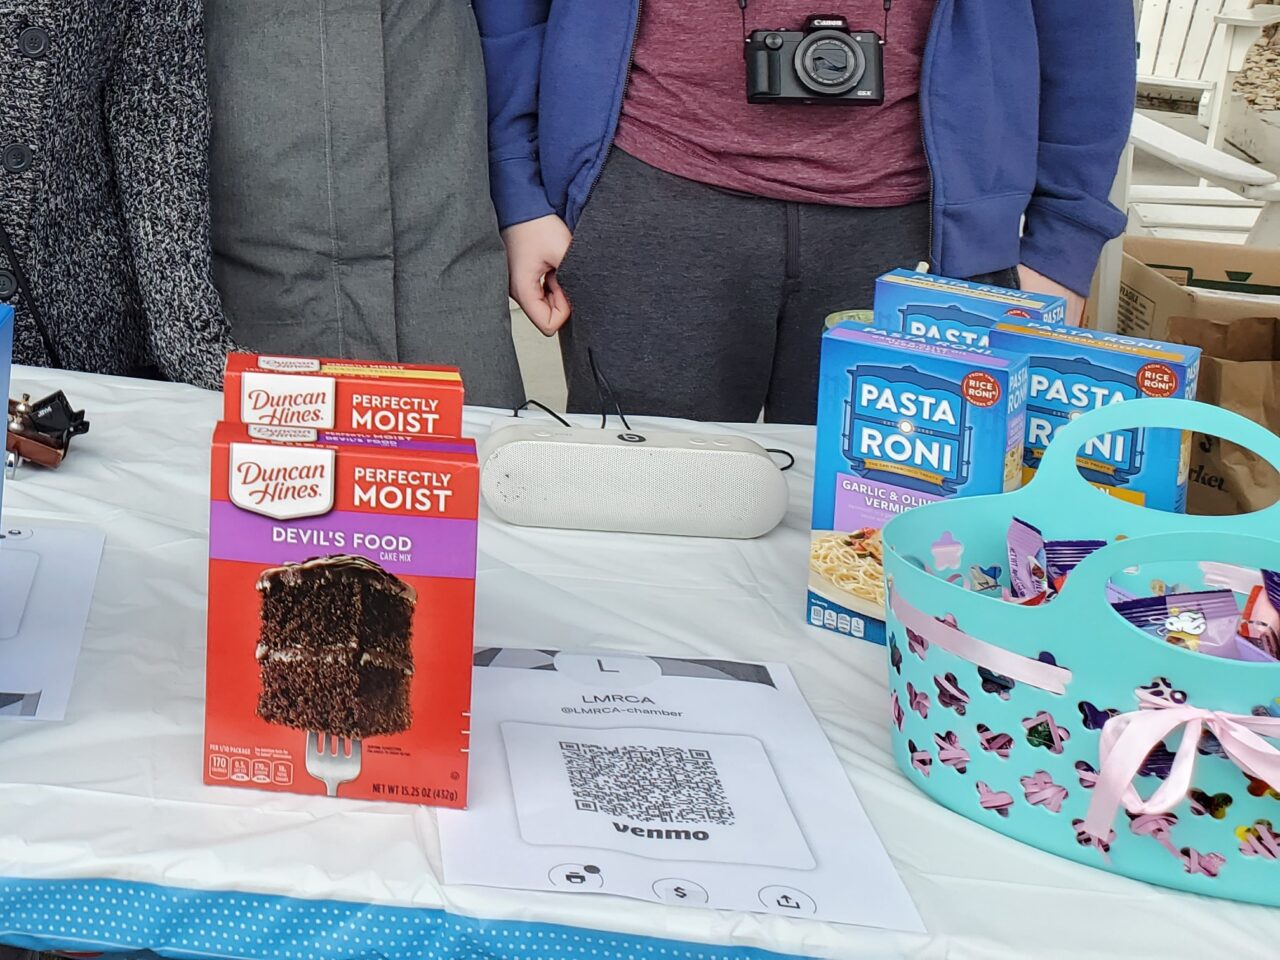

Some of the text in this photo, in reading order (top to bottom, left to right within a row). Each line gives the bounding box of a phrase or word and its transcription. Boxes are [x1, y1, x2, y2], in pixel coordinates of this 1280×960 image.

[911, 275, 969, 288] PASTA
[976, 286, 1032, 298] RONI
[1042, 305, 1064, 324] PASTA
[862, 327, 928, 342] PASTA
[935, 341, 991, 355] RONI
[911, 321, 990, 347] PASTA
[1026, 322, 1160, 350] PASTA RONI
[968, 379, 993, 390] RICE
[1144, 379, 1171, 390] RONI
[1145, 371, 1170, 381] RICE
[248, 389, 326, 410] Duncan
[352, 393, 439, 410] PERFECTLY
[968, 387, 995, 399] RONI
[860, 383, 956, 425] PASTA
[351, 410, 440, 434] MOIST
[325, 435, 398, 446] DEVIL'S FOOD
[373, 433, 412, 441] MOIST
[1028, 417, 1125, 462] RNI
[860, 427, 953, 472] RONI
[237, 461, 325, 485] Duncan
[354, 467, 452, 487] PERFECTLY
[353, 483, 453, 513] MOIST
[842, 480, 887, 499] GARLIC
[889, 492, 899, 501] &
[272, 527, 412, 552] DEVIL'S FOOD
[379, 551, 412, 562] CAKE MIX
[598, 659, 620, 674] L
[581, 694, 656, 706] LMRCA
[561, 706, 683, 718] @LMRCA-chamber
[213, 756, 226, 767] 170
[372, 783, 458, 801] NET WT 15.25 OZ (432g)
[612, 822, 710, 842] venmo
